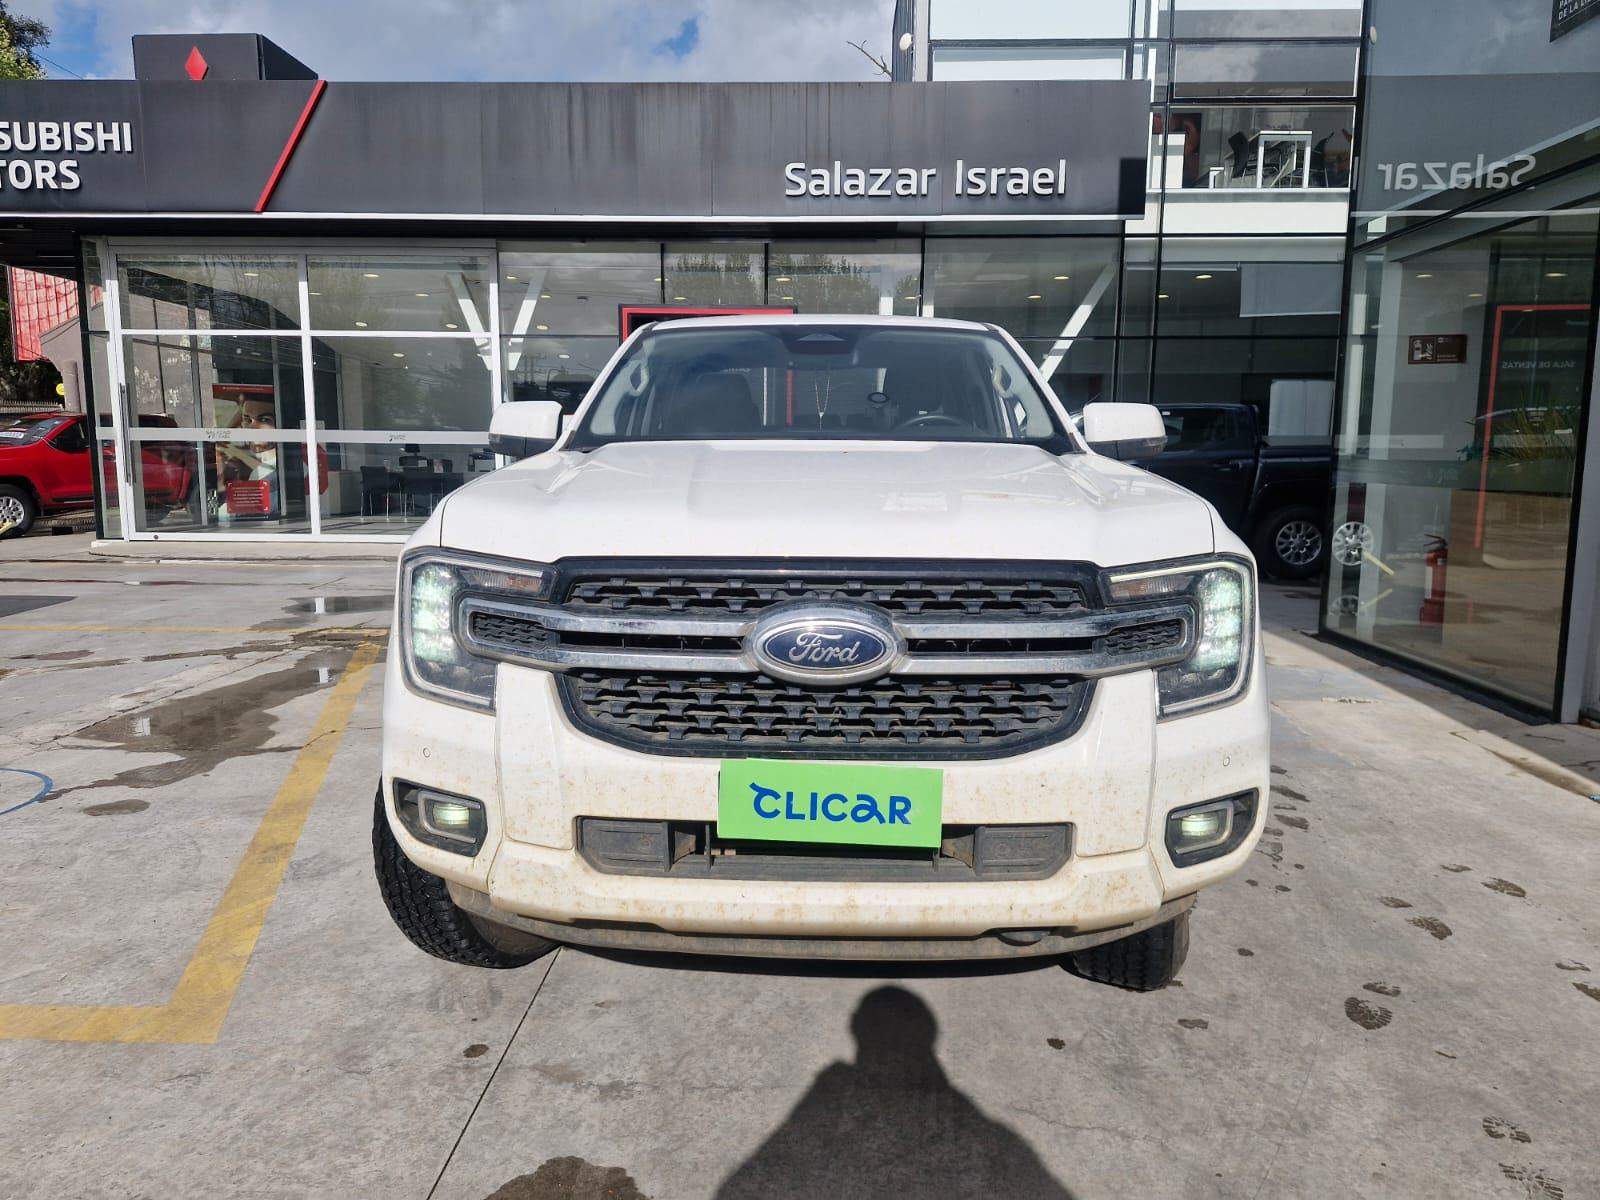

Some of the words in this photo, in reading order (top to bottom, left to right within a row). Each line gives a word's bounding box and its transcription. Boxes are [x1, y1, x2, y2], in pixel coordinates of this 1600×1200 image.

[784, 160, 937, 197] Salazar
[955, 159, 1067, 195] Israel
[788, 631, 861, 663] Ford
